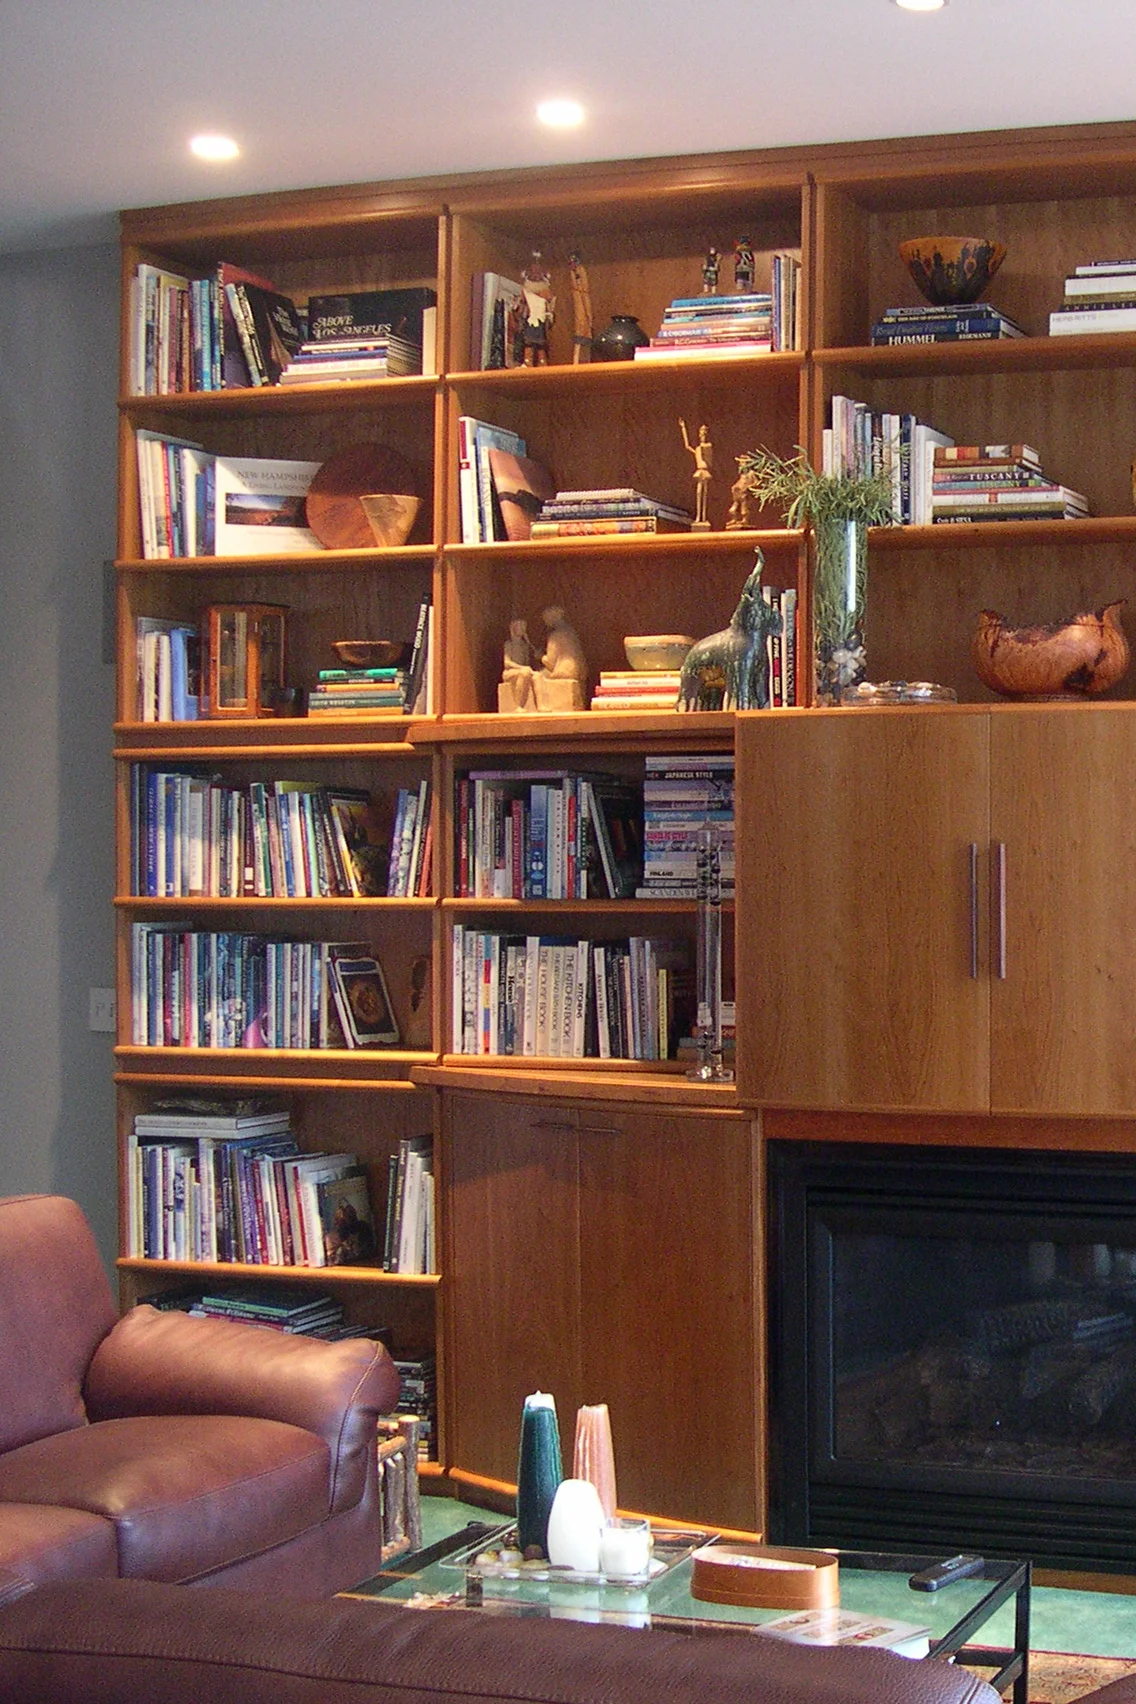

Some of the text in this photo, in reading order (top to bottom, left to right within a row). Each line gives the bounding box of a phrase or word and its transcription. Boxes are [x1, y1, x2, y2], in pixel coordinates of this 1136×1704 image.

[312, 315, 354, 330] ABOVE
[312, 323, 392, 340] LOS ANGELES
[888, 334, 937, 346] HUMMEL
[969, 472, 1019, 480] TUSCANY
[562, 954, 574, 1037] THE KITCHEN BOOK
